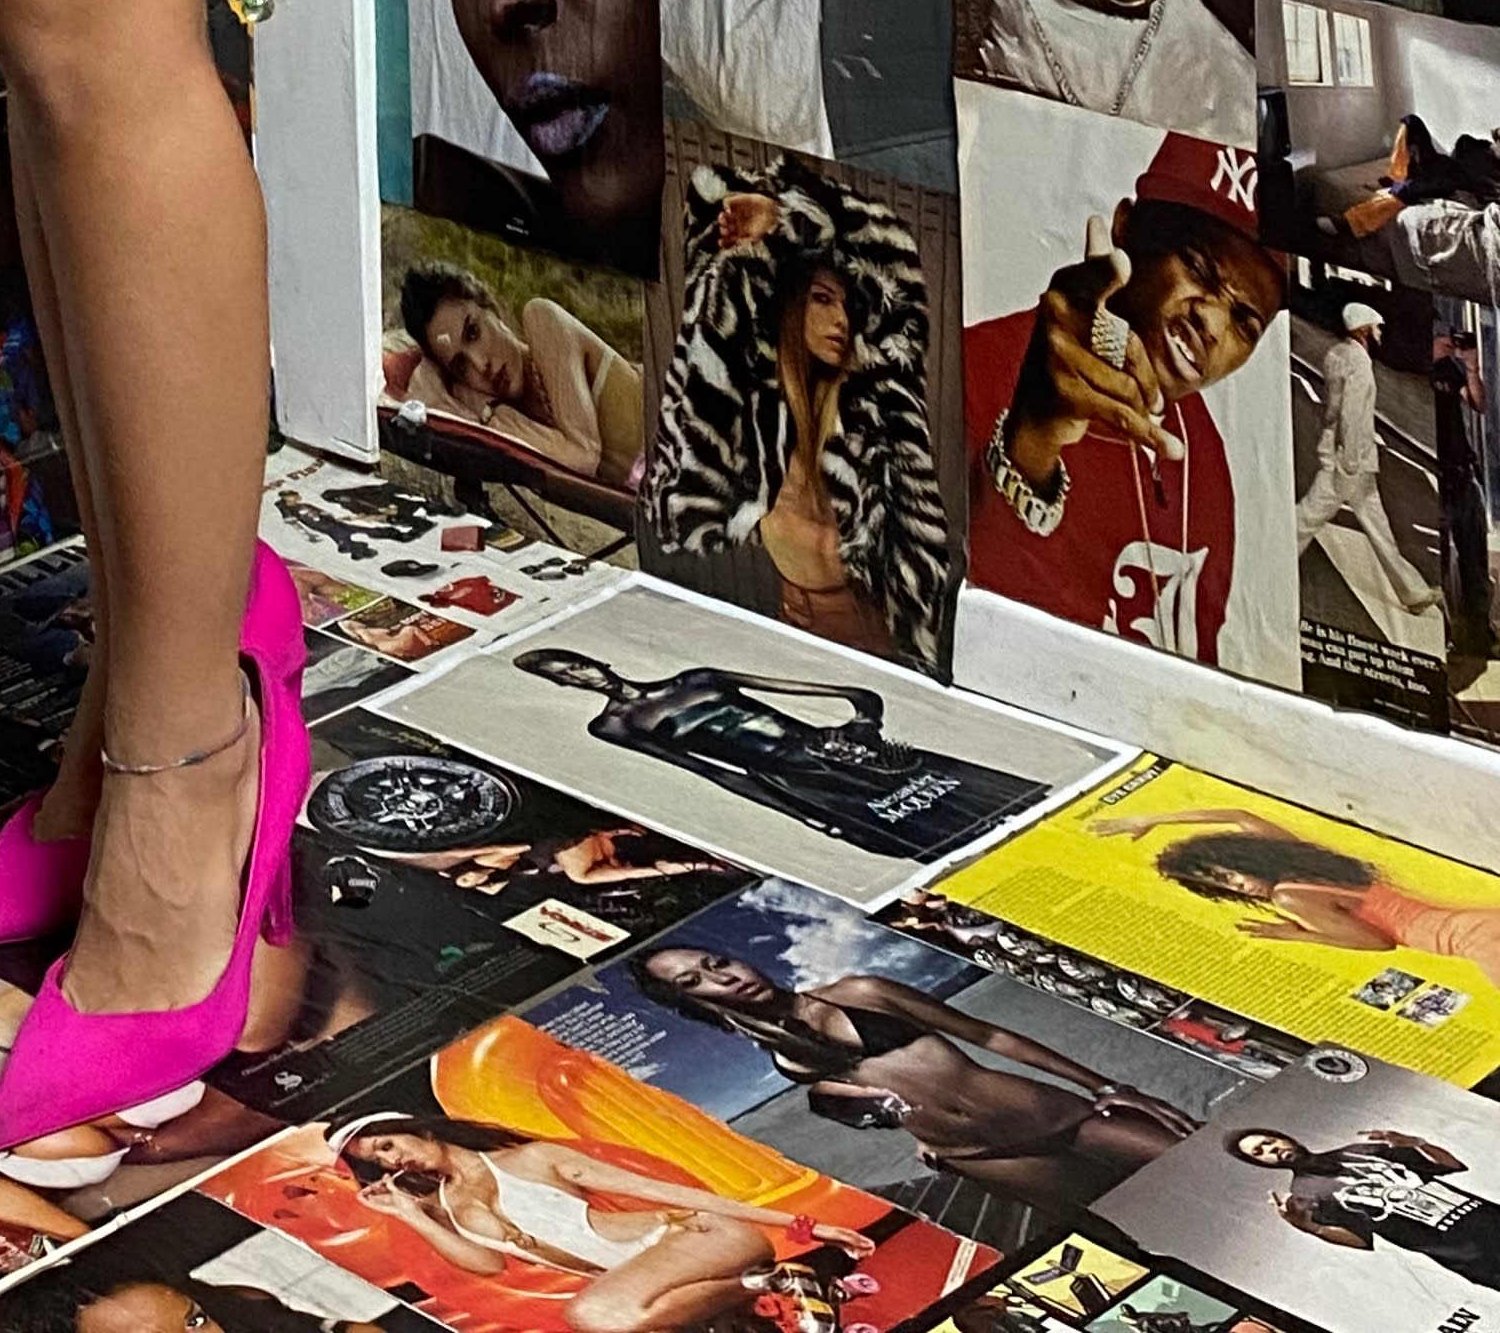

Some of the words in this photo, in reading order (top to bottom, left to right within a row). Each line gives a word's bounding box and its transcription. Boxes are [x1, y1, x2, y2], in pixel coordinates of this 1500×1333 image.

[1316, 623, 1328, 639] is
[1328, 627, 1346, 643] his
[1347, 634, 1379, 653] finest
[1380, 646, 1409, 663] work
[1325, 643, 1347, 657] can
[1347, 649, 1368, 664] put
[1369, 654, 1386, 670] up
[1386, 659, 1416, 678] them
[1318, 652, 1342, 670] And
[1343, 659, 1363, 675] the
[866, 773, 936, 815] Alexander
